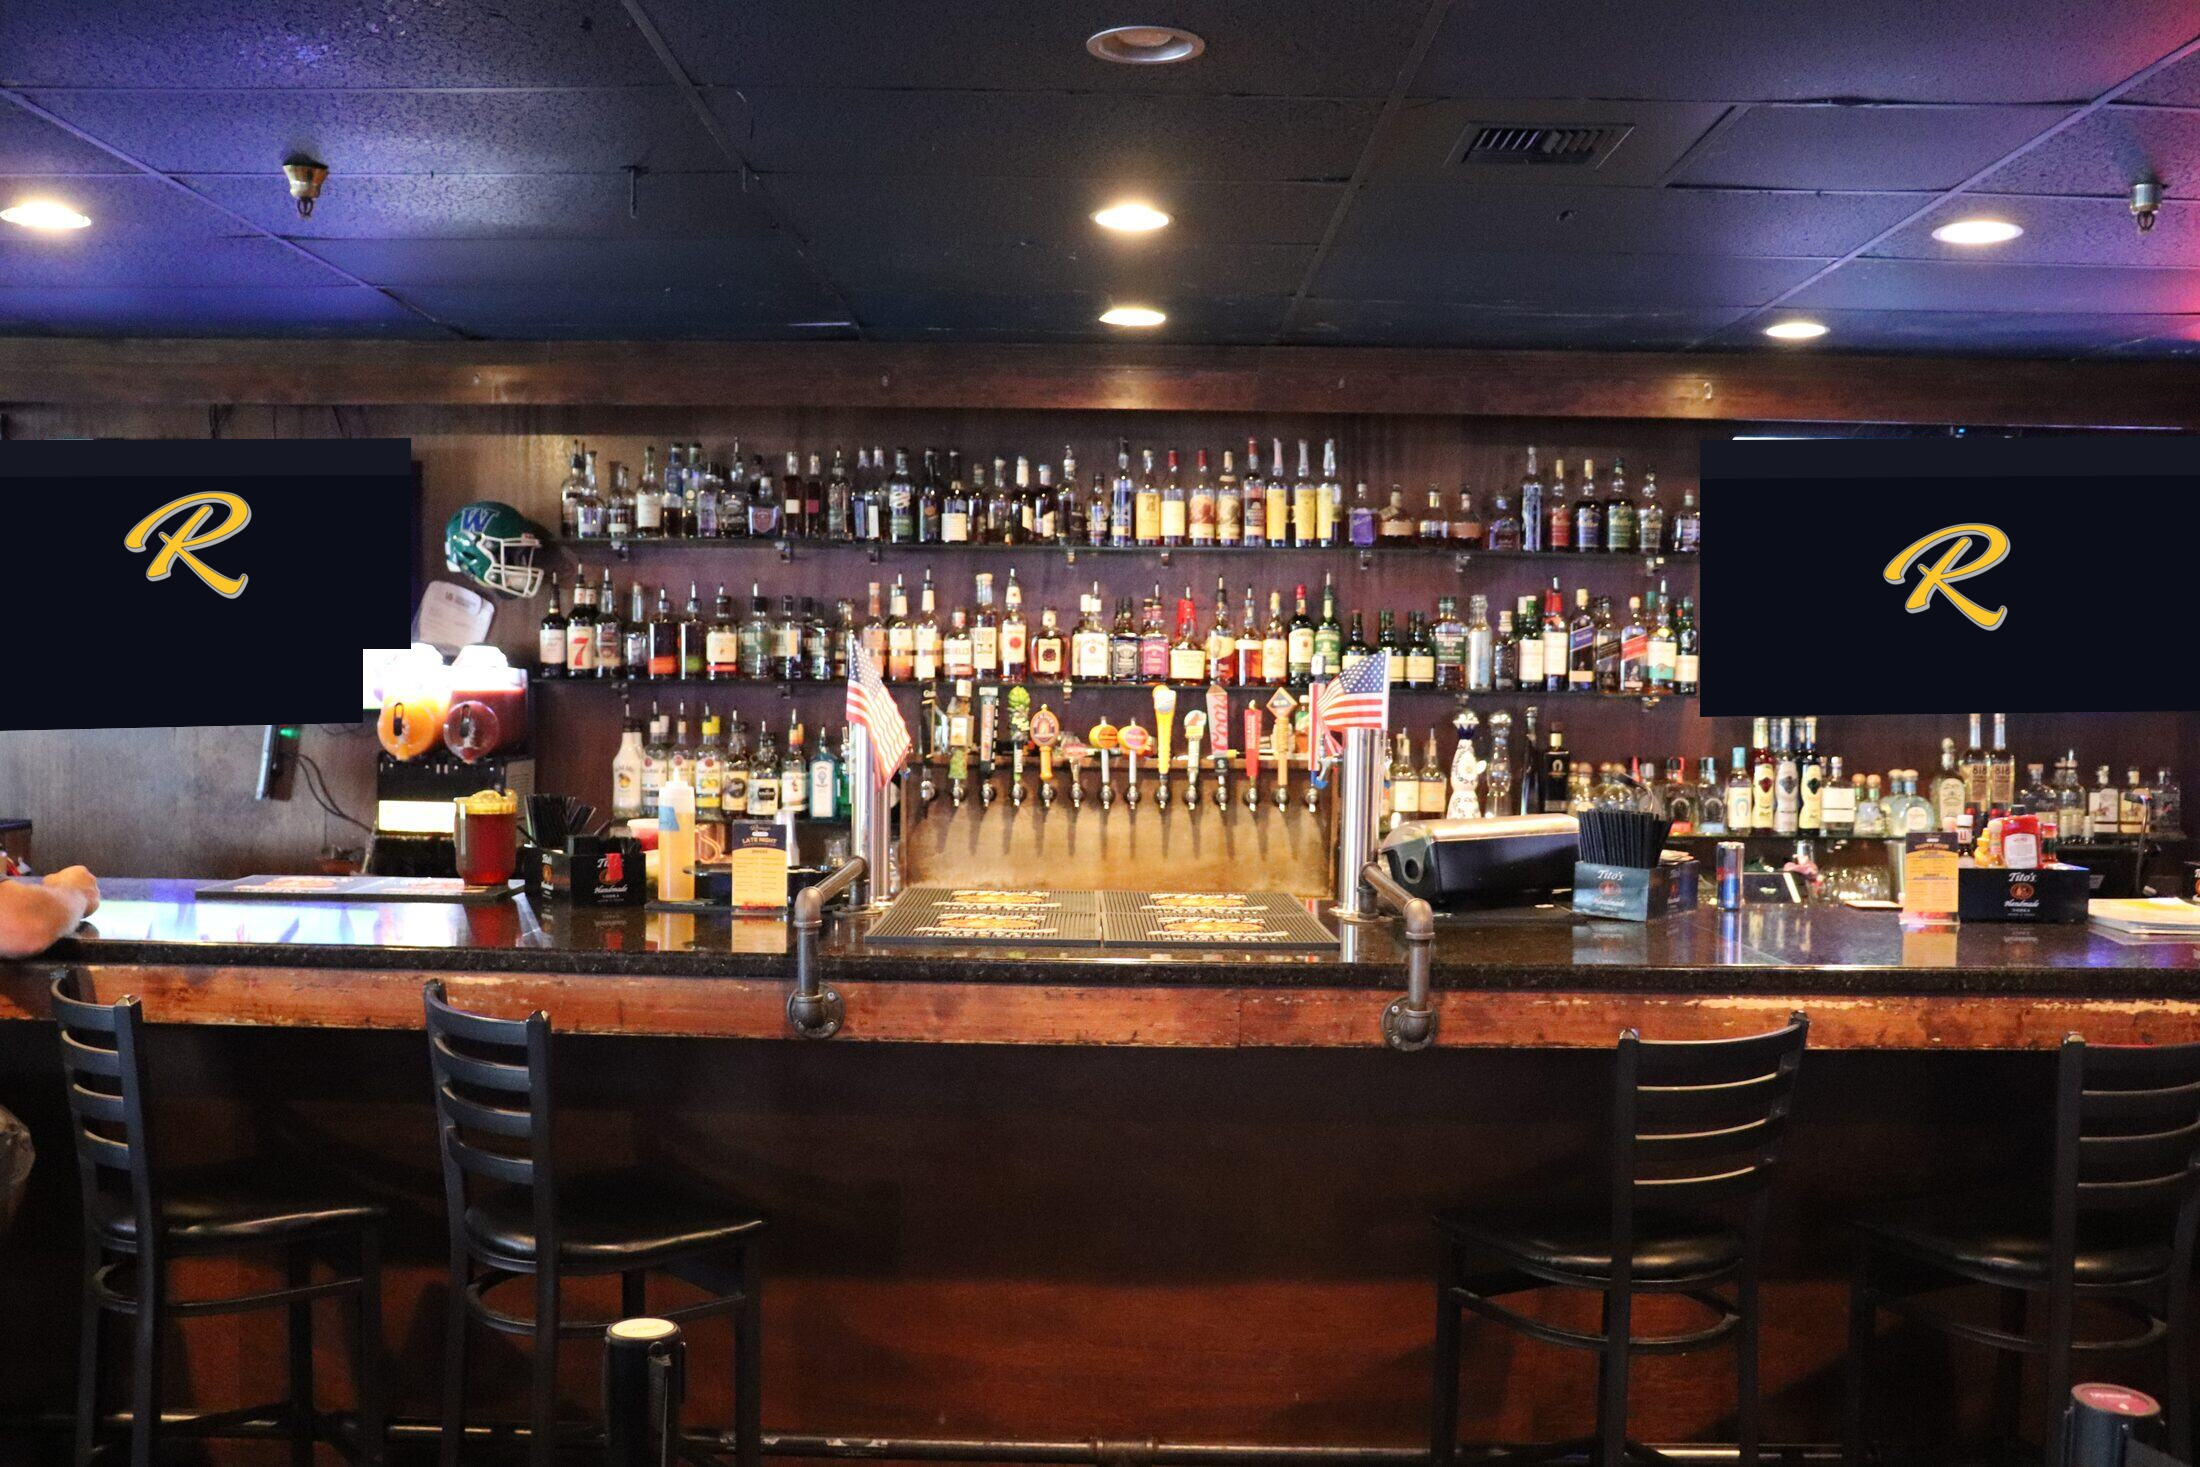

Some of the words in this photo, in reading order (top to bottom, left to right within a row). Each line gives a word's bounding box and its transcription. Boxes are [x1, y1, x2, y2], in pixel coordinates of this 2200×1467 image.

[461, 507, 500, 535] W
[124, 490, 252, 599] R
[1882, 522, 2011, 631] R
[573, 637, 589, 666] 7
[1213, 695, 1229, 751] Coors
[1994, 765, 2011, 775] 818
[1597, 869, 1625, 880] Tito's
[2008, 871, 2037, 882] Tito's
